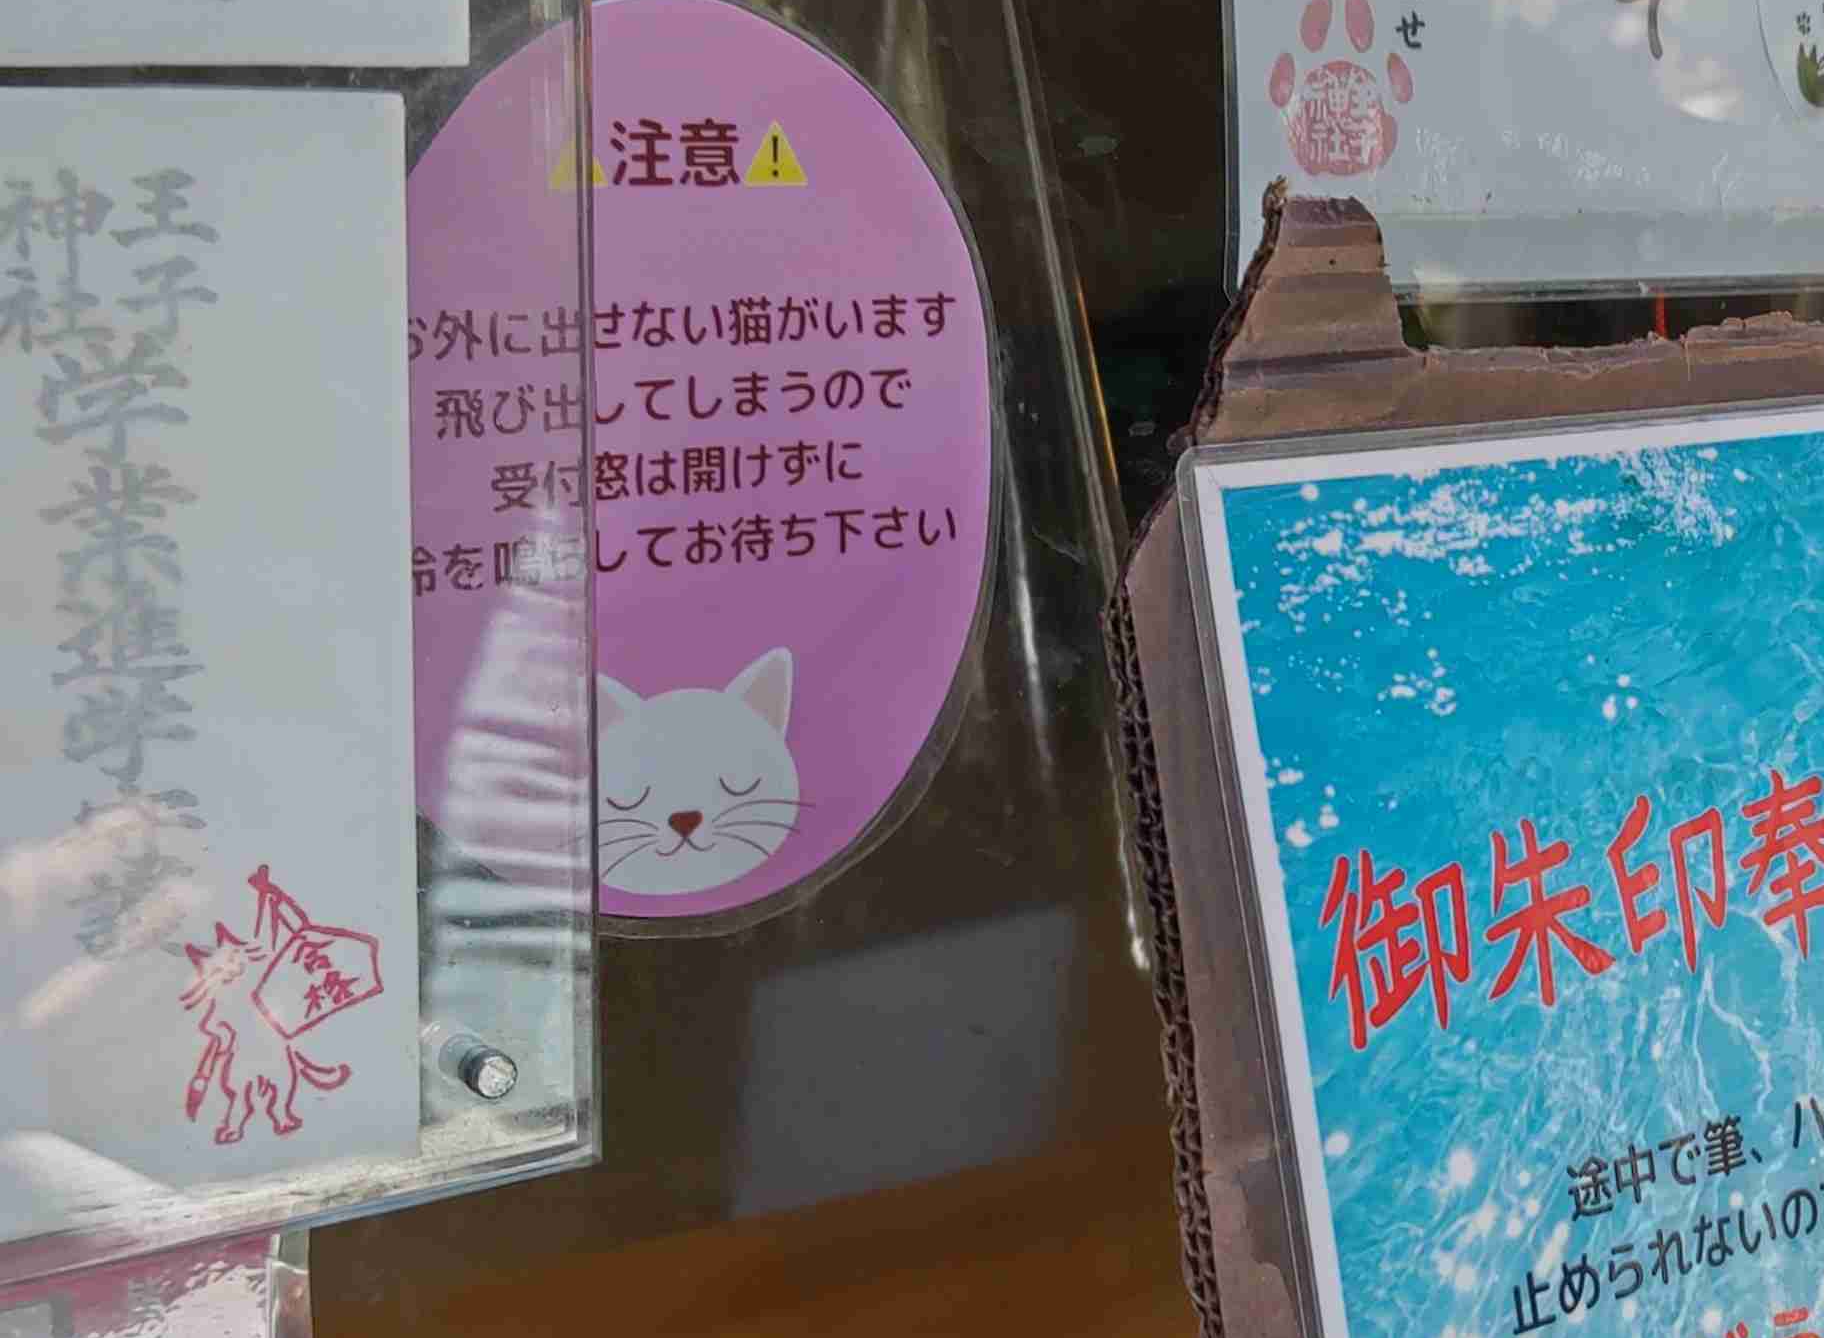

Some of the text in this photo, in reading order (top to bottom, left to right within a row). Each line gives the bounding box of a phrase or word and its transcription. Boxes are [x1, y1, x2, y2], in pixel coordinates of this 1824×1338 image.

[611, 120, 740, 188] 注意
[108, 167, 220, 347] 王子
[434, 367, 913, 439] 飛び出してしまうので
[490, 441, 864, 513] 受付窓は開けずに
[292, 938, 362, 1019] 合格
